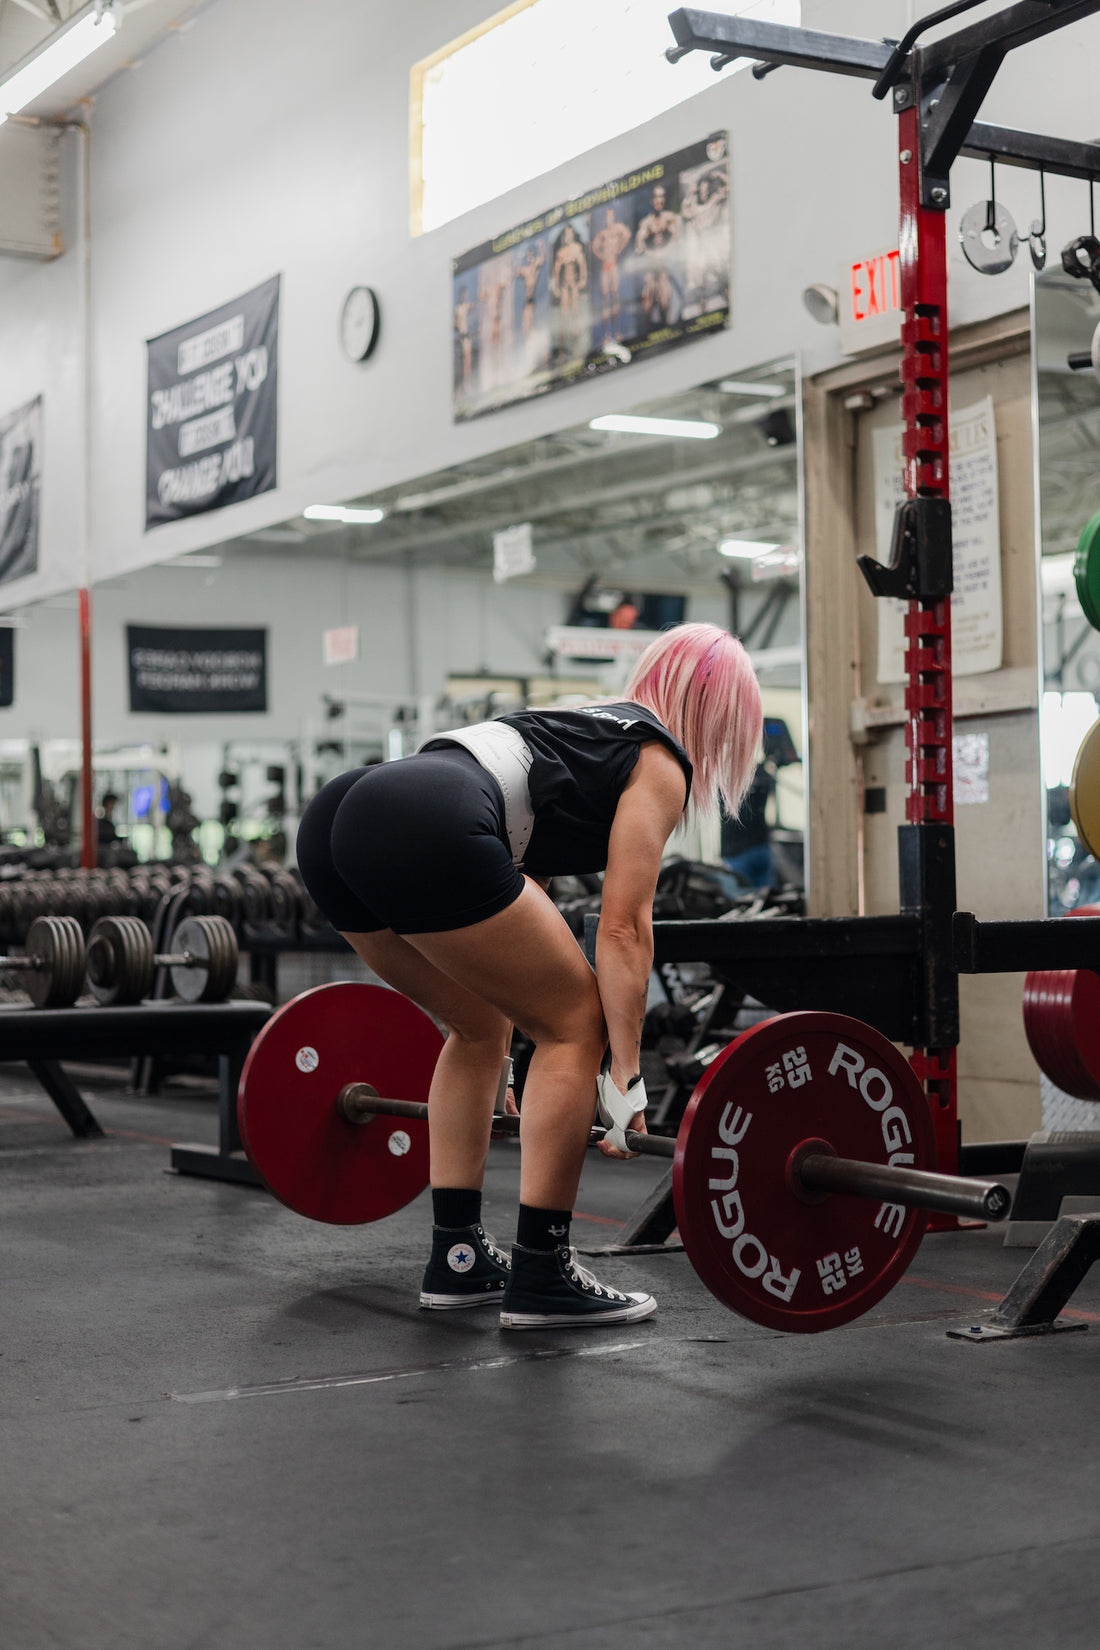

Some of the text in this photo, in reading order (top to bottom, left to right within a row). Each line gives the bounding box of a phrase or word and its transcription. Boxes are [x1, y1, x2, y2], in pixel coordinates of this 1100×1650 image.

[851, 249, 899, 322] EXIT
[765, 1062, 785, 1094] KG
[782, 1045, 813, 1090] 25
[708, 1100, 802, 1304] ROGUE
[816, 1250, 848, 1296] 25
[844, 1246, 865, 1278] KG
